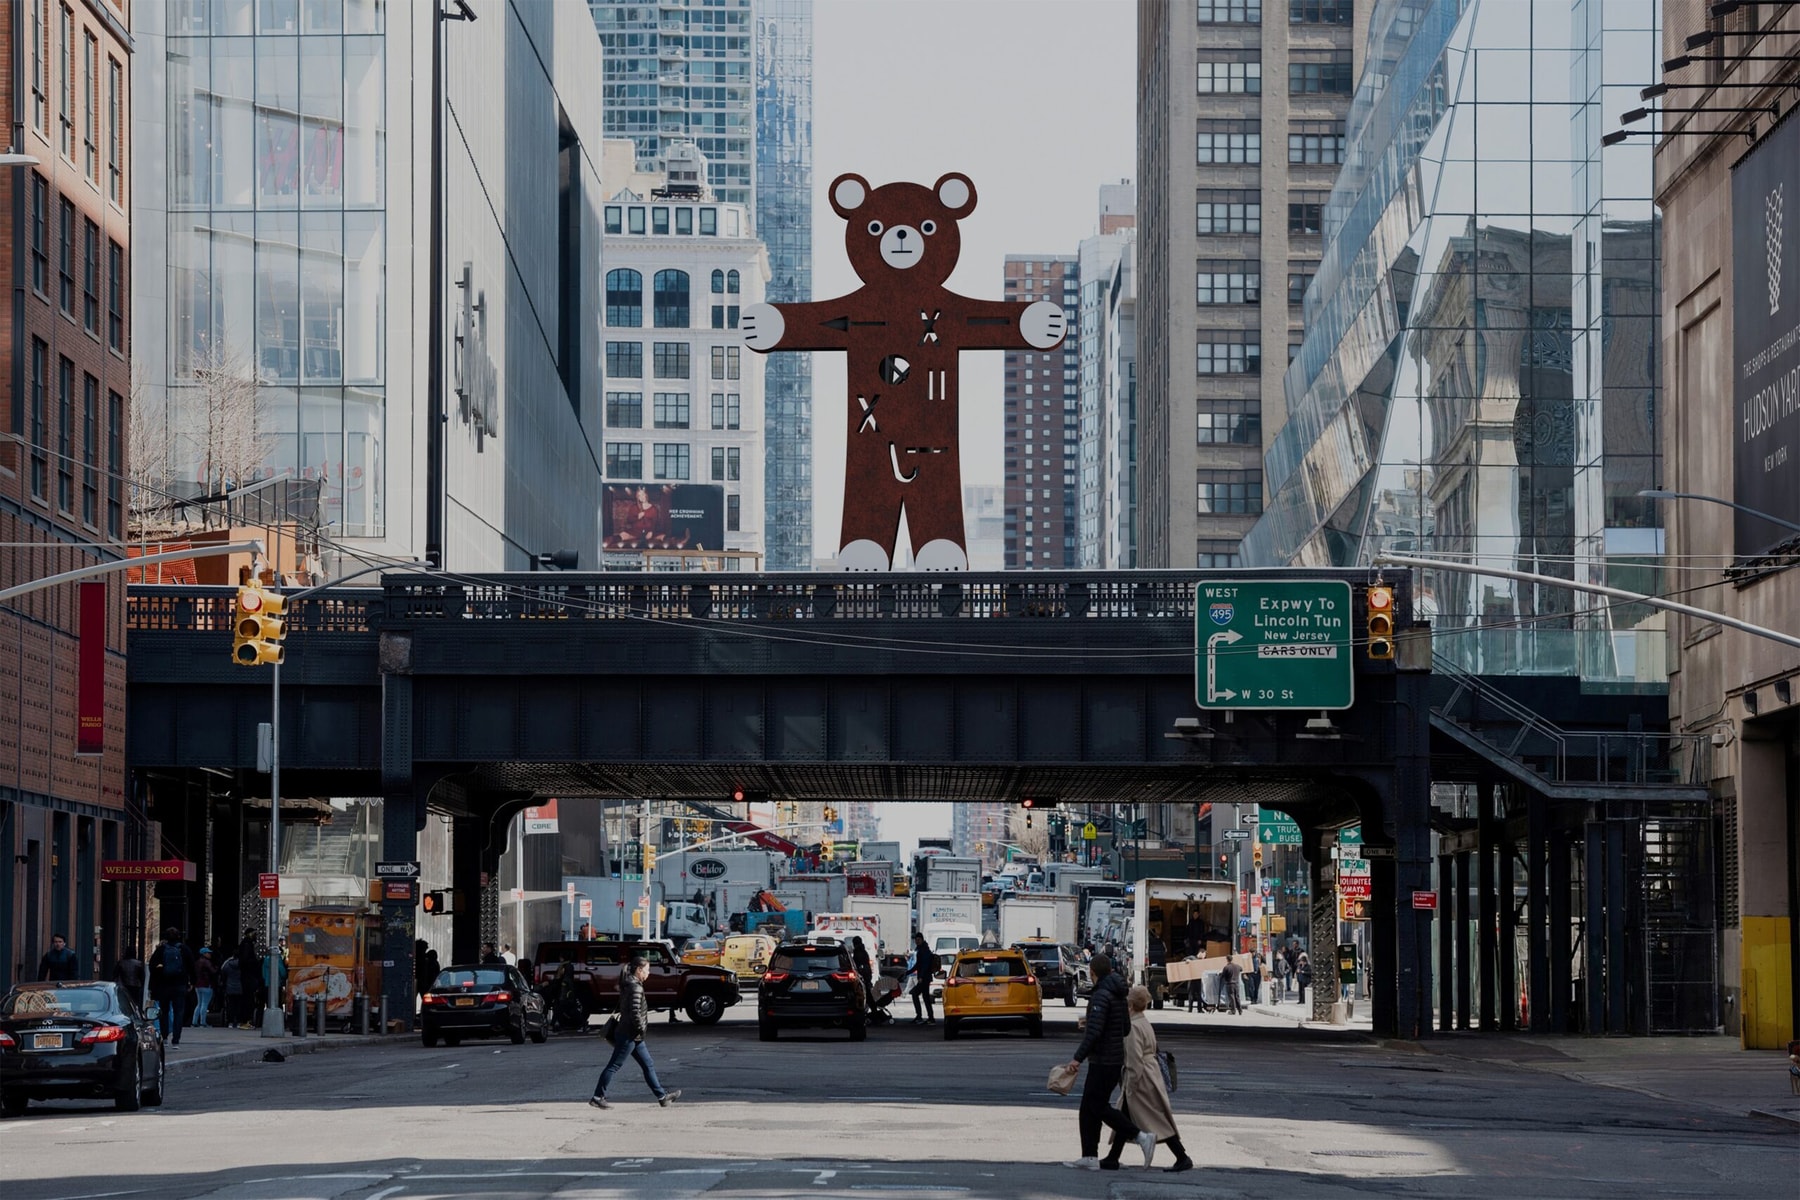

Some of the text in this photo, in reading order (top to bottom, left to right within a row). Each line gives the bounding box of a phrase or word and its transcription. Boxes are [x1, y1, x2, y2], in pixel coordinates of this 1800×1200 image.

[1743, 363, 1752, 379] THE
[1752, 349, 1767, 374] SHOPS
[1767, 346, 1771, 362] &
[1743, 385, 1779, 444] HUDSON
[1764, 444, 1788, 473] NEW YORK
[1205, 588, 1239, 598] WEST
[1260, 597, 1336, 612] Expwy To
[1211, 609, 1232, 620] 495
[1254, 614, 1342, 628] Lincoln Tun
[1264, 630, 1331, 642] New Jersey
[1262, 646, 1332, 656] CARS ONLY
[1241, 689, 1294, 699] W 30 St
[105, 866, 179, 875] WELLS FARGO
